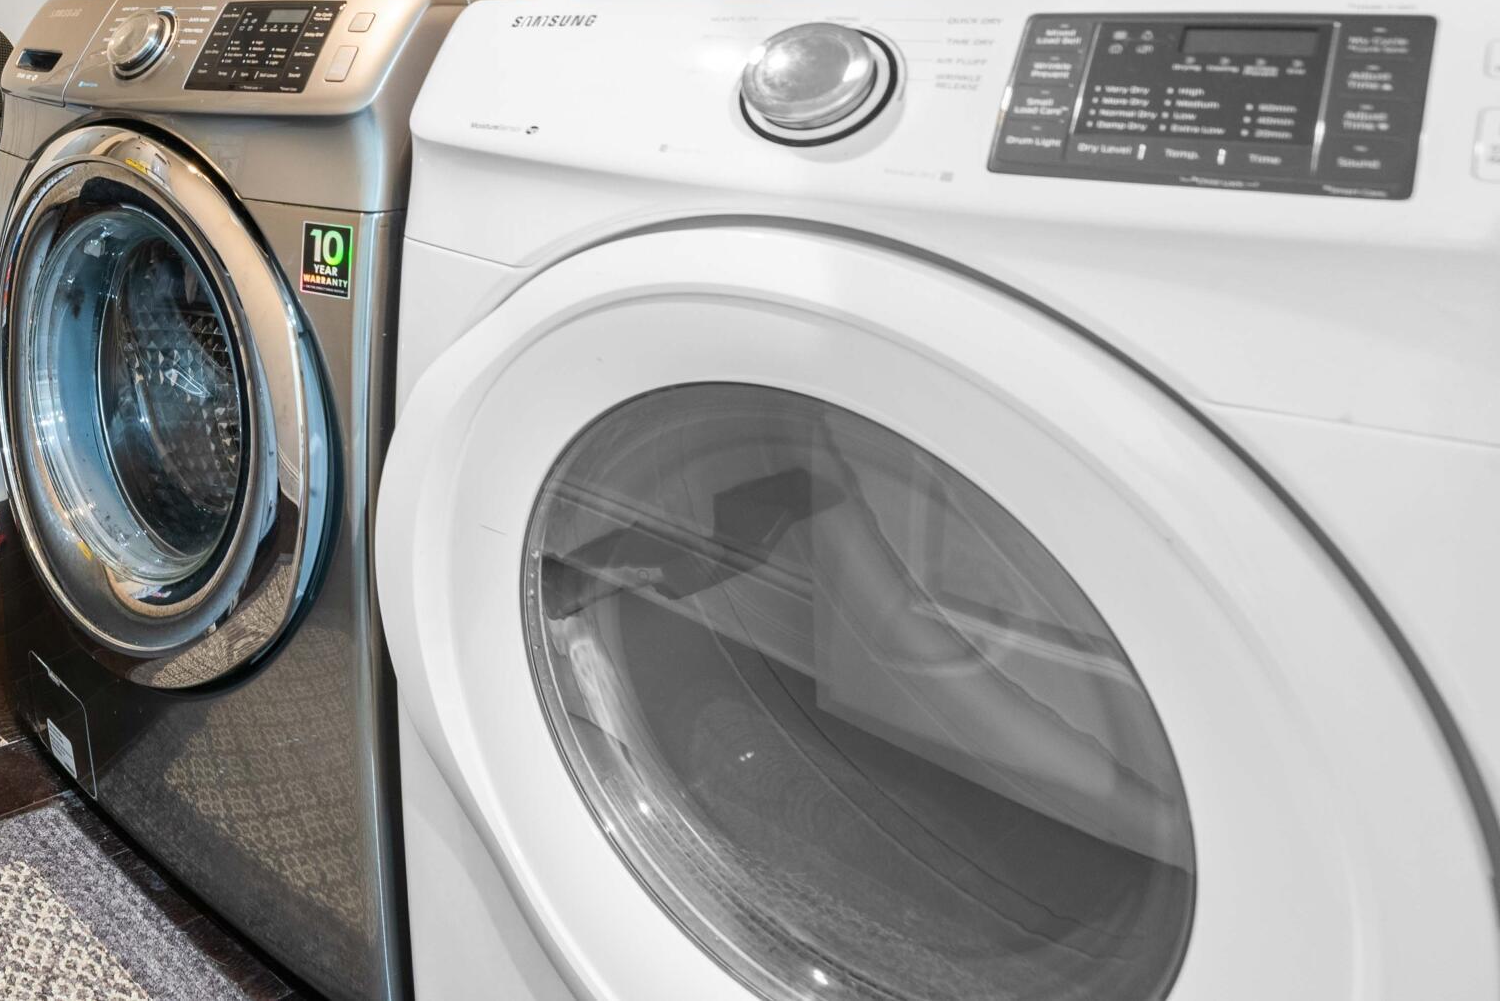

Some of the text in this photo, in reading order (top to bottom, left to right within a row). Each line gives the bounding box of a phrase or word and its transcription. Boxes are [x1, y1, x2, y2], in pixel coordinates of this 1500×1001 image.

[511, 14, 598, 28] SAMSUNG
[1129, 85, 1150, 95] Dry
[1177, 86, 1205, 97] High
[1129, 97, 1150, 107] Dry
[1098, 108, 1158, 120] Normal Dry
[1127, 121, 1148, 132] Dry
[1076, 142, 1099, 153] Dry
[310, 228, 344, 266] 10
[313, 263, 338, 277] YEAR
[303, 273, 348, 288] WARRANTY
